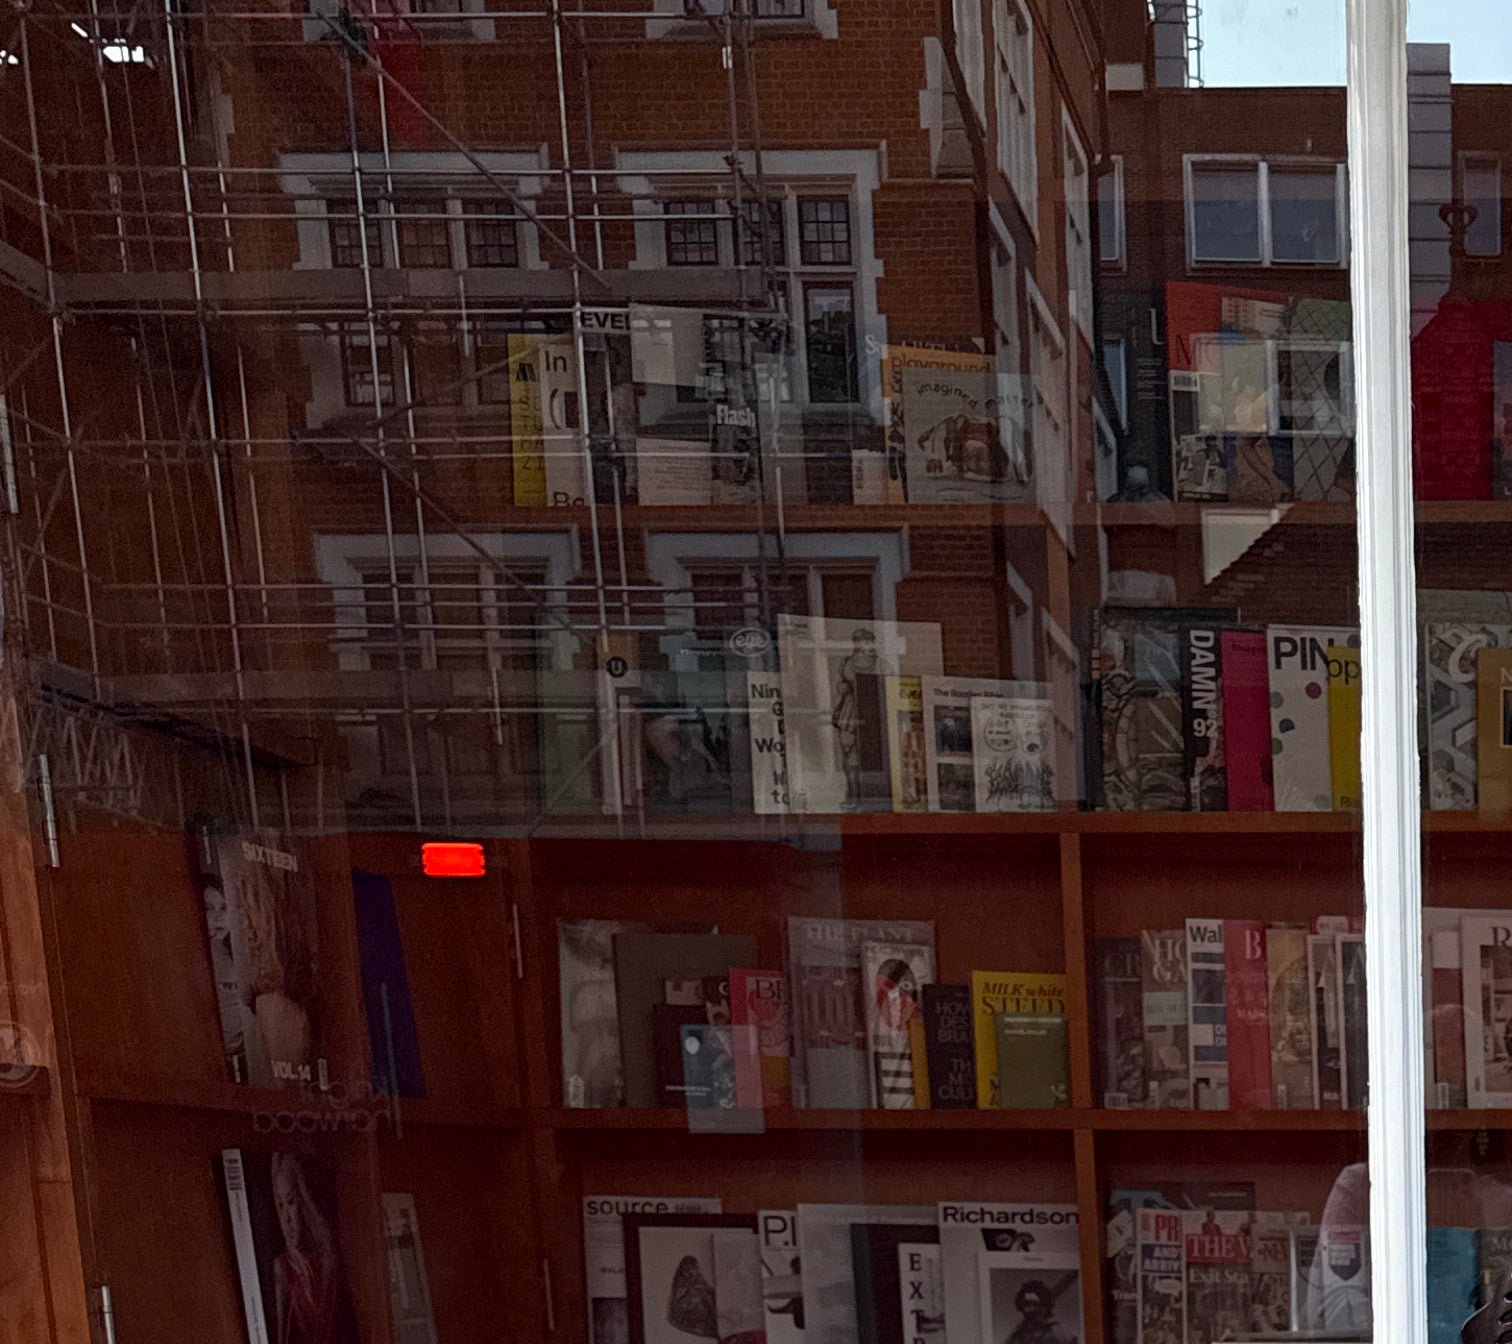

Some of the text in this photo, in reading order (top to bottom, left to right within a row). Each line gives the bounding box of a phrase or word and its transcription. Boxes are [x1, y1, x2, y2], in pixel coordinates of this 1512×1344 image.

[891, 354, 991, 373] playground
[1193, 717, 1218, 738] 92
[241, 841, 298, 872] SIXTEEN
[803, 923, 842, 942] THE
[1189, 926, 1222, 943] Wal
[982, 983, 1065, 997] MILK white
[587, 1200, 669, 1215] source
[942, 1205, 1079, 1226] Richardson
[1190, 1235, 1234, 1258] THE
[1189, 1268, 1220, 1284] Exit
